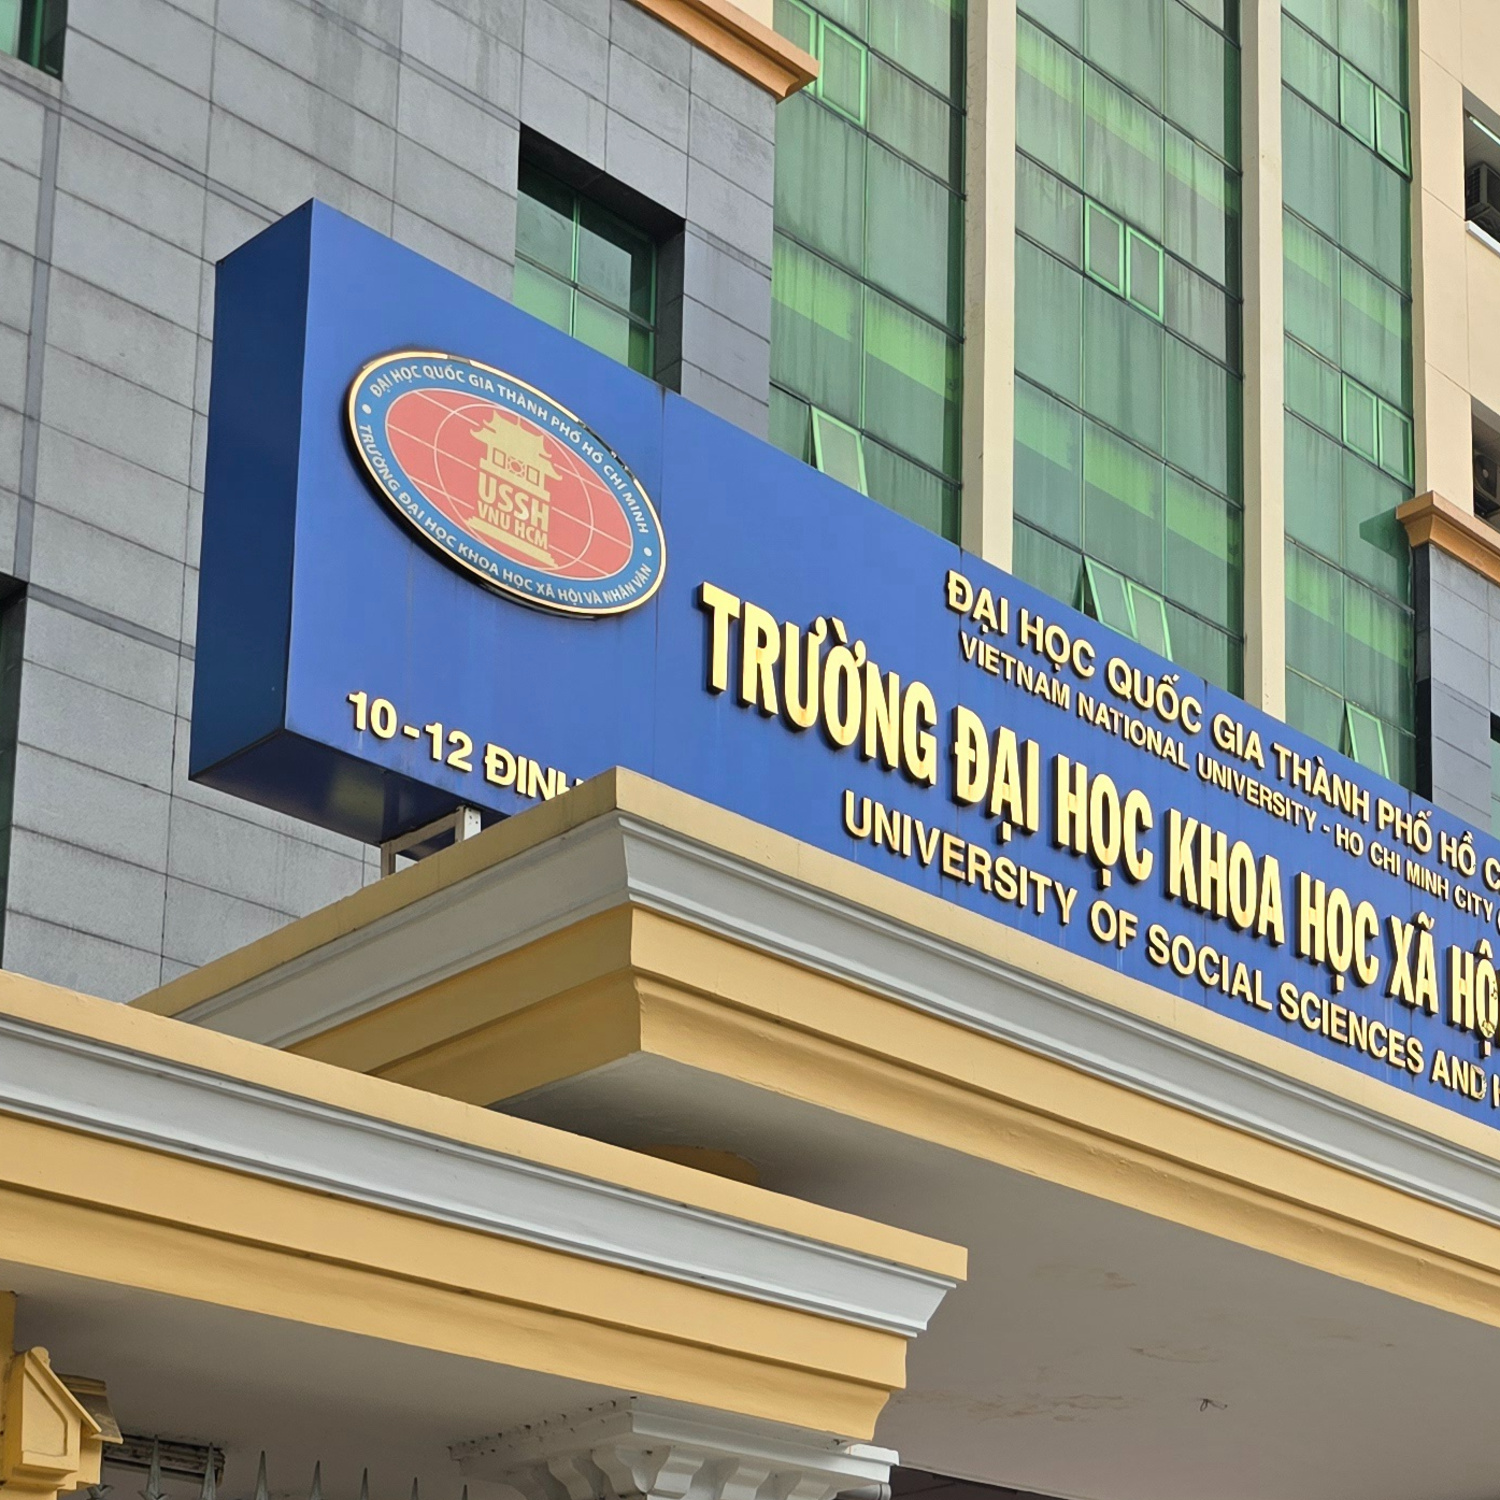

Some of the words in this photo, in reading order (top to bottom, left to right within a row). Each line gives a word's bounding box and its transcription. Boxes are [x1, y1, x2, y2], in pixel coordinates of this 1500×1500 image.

[359, 423, 400, 493] TRƯỜNG
[398, 492, 425, 520] ĐẠI
[424, 516, 456, 548] HỌC
[458, 544, 500, 575] KHOA
[503, 569, 533, 591] HỌC
[535, 580, 555, 599] XÃ
[558, 586, 583, 606] HỘI
[584, 588, 603, 605] VÀ
[603, 578, 636, 603] NHÂN
[370, 374, 392, 398] ĐẠI
[390, 365, 422, 384] HỌC
[424, 364, 465, 384] QUỐC
[469, 374, 495, 393] GIA
[497, 384, 548, 421] THÀNH
[551, 416, 582, 444] PHỐ
[603, 463, 627, 493] CHÍ
[622, 490, 649, 534] MINH
[478, 473, 550, 531] USSH
[478, 500, 513, 533] VNU
[514, 521, 550, 549] HCM
[700, 581, 938, 787] TRƯỜNG
[951, 705, 1040, 843] ĐẠI
[1052, 753, 1154, 888] HỌC
[1167, 808, 1285, 946] KHOA
[1297, 871, 1380, 993] HỌC
[1387, 911, 1440, 1015] XÃ
[947, 570, 1009, 634] ĐẠI
[1020, 608, 1095, 678] HỌC
[1107, 656, 1202, 734] QUỐC
[1212, 713, 1266, 769] GIA
[1273, 742, 1370, 823] THÀNH
[1377, 797, 1432, 853] PHỐ
[1440, 830, 1476, 876] HỒ
[960, 631, 1070, 710] VIETNAM
[1077, 692, 1190, 770] NATIONAL
[1197, 753, 1318, 832] UNIVERSITY
[1335, 823, 1364, 857] HO
[1370, 841, 1401, 876] CHI
[1406, 858, 1449, 900] MINH
[1454, 885, 1494, 925] CITY
[844, 789, 1079, 926] UNIVERSITY
[1089, 900, 1138, 948] OF
[1147, 924, 1273, 1012] SOCIAL
[1278, 982, 1424, 1074] SCIENCES
[1430, 1050, 1488, 1101] AND
